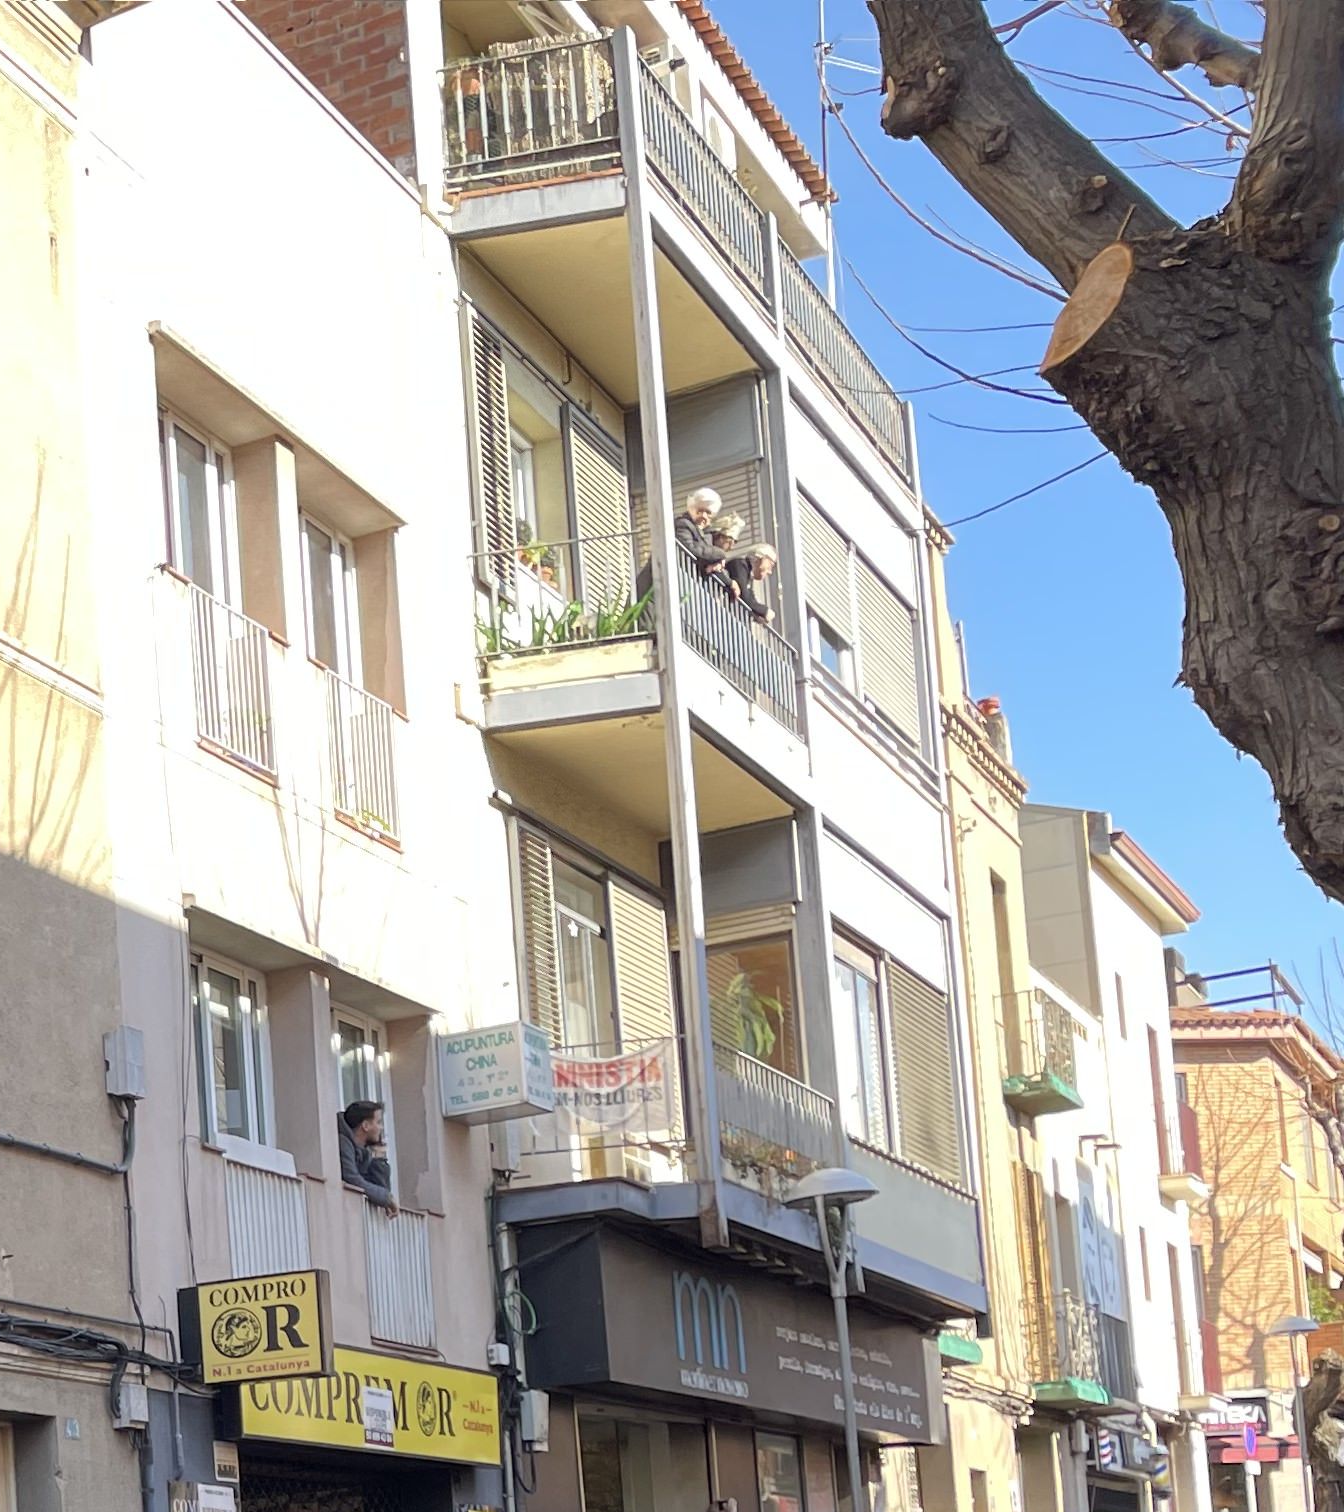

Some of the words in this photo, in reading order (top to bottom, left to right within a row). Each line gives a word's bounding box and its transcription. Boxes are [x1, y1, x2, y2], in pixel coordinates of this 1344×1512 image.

[446, 1031, 515, 1056] ACUPUNTURA
[466, 1053, 498, 1071] CHINA
[208, 1277, 307, 1308] COMPRO
[246, 1360, 310, 1375] Catalunya
[248, 1370, 410, 1432] COMPRM
